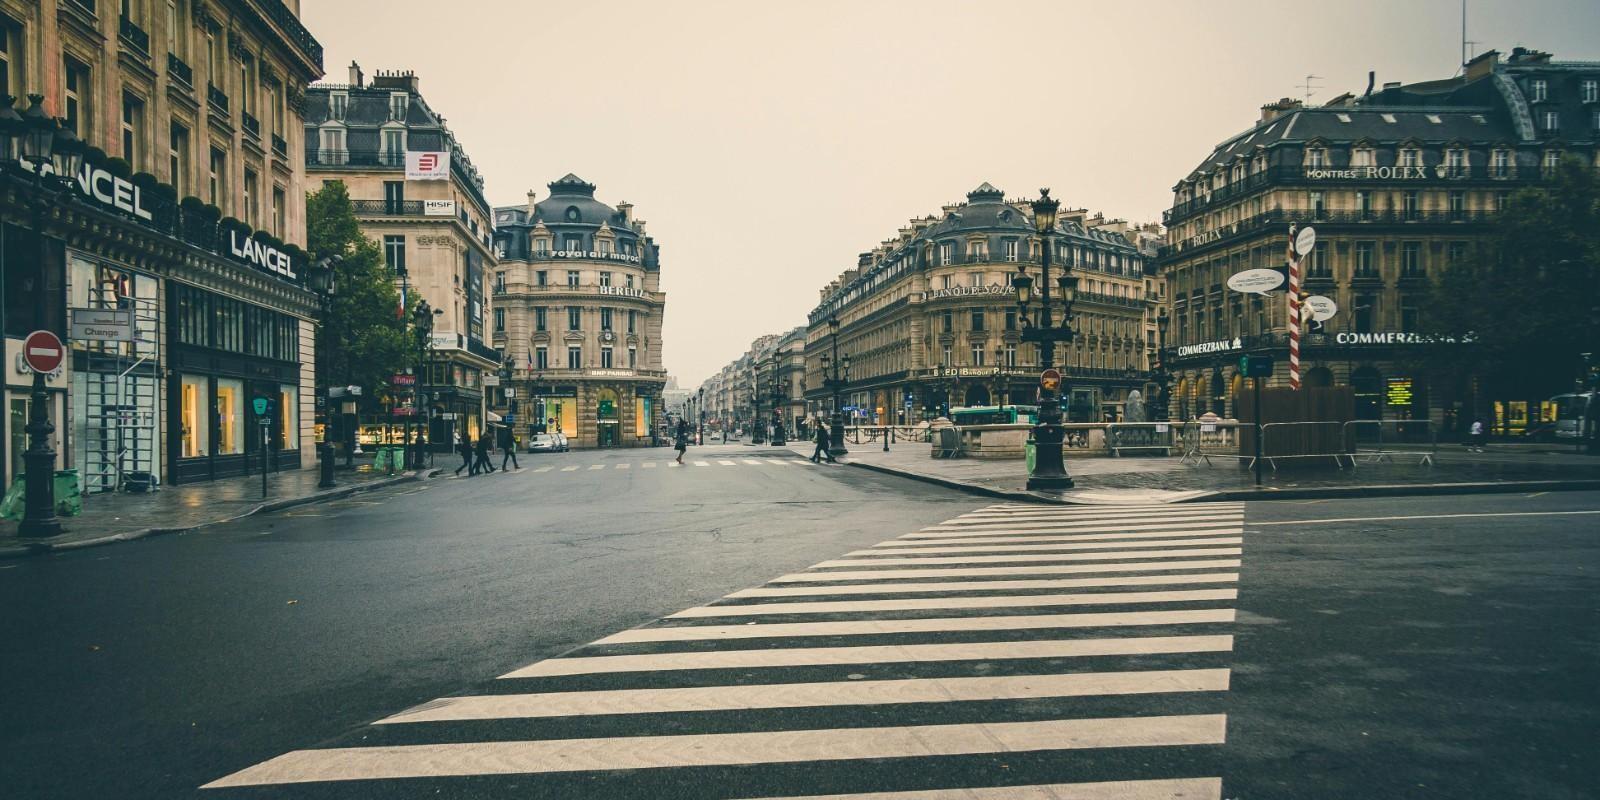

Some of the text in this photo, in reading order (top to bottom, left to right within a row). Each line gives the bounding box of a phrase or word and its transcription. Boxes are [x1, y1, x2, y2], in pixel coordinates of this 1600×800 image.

[1306, 166, 1427, 179] MONTRES ROLEX
[1193, 229, 1222, 247] ROLEX
[231, 229, 297, 280] LANCEL
[551, 250, 639, 262] royal air maroc
[600, 285, 644, 297] BERLITZ
[933, 286, 978, 298] BANQUE
[84, 327, 120, 337] Change
[1178, 340, 1230, 356] COMMERZBANK
[933, 367, 958, 377] BED
